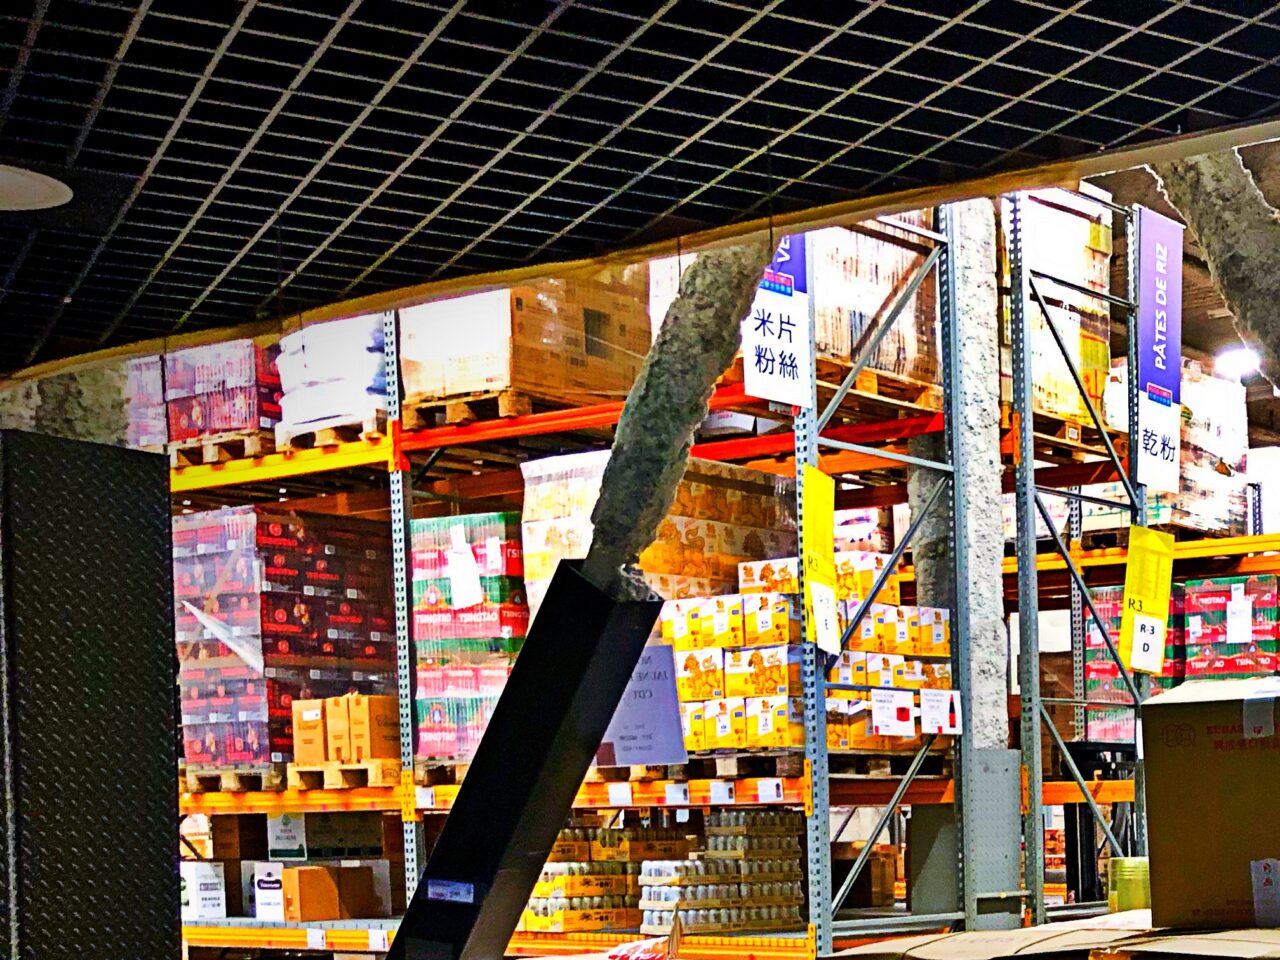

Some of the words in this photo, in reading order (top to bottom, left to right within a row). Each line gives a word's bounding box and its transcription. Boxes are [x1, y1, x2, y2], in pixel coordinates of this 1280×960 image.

[1155, 242, 1168, 274] RIZ
[1155, 278, 1168, 306] DE
[754, 307, 797, 343] 米片
[1153, 308, 1168, 370] PÂTES
[754, 344, 799, 381] 粉絲
[1142, 427, 1175, 462] 乾粉
[1128, 598, 1143, 612] R3
[415, 614, 451, 624] TSINGTAO
[458, 612, 498, 623] TSINGTAO
[1140, 623, 1155, 635] R-3
[1143, 642, 1150, 653] D
[1191, 659, 1225, 669] TSINAO
[1236, 657, 1271, 667] TSINTAO
[419, 731, 456, 742] TSINGTAO
